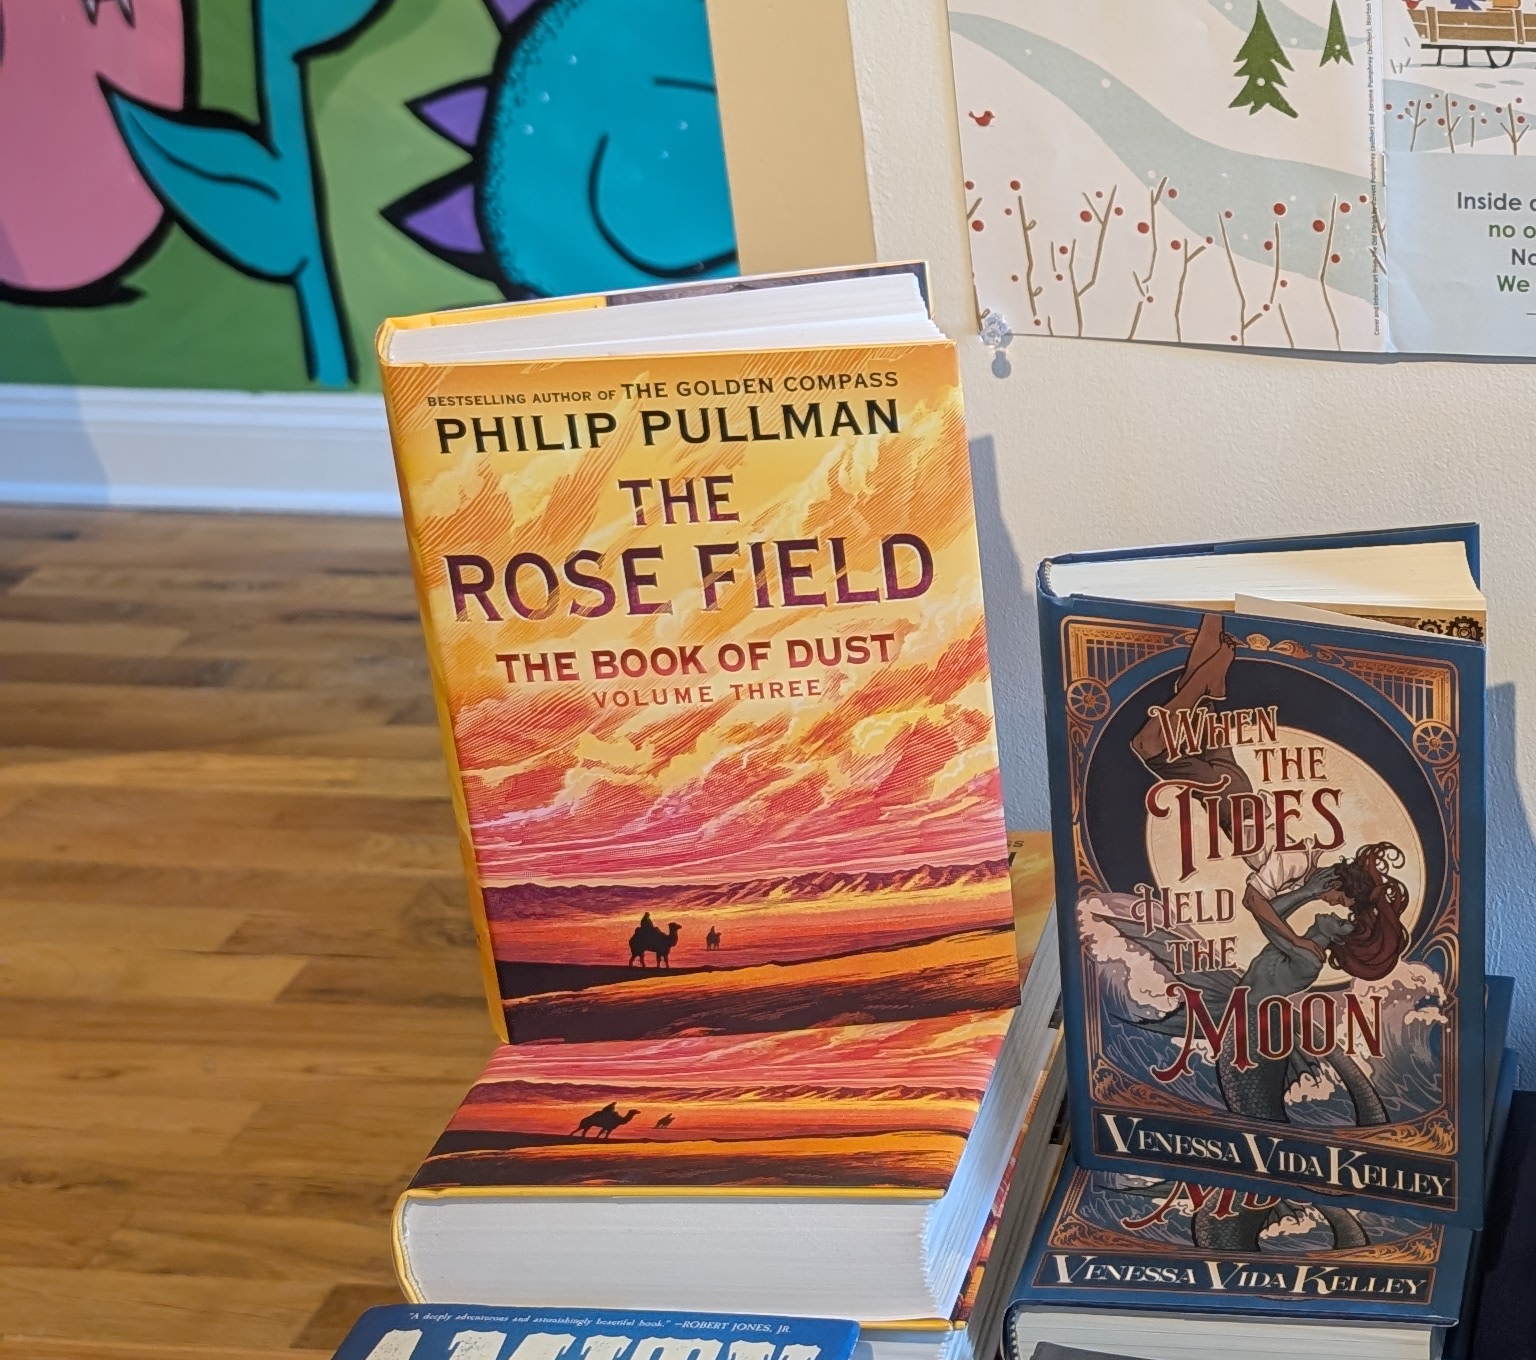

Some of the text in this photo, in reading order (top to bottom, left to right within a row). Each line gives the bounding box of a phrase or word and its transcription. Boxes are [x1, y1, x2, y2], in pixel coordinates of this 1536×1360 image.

[1457, 192, 1522, 212] Inside
[1489, 223, 1515, 238] no
[1497, 275, 1530, 292] We
[427, 371, 899, 406] BESTSELLING AUTHOR OF THE GOLDEN COMPASS
[435, 399, 900, 454] PHILIP PULLMAN
[617, 474, 740, 527] THE
[444, 533, 934, 623] ROSE FIELD
[495, 633, 895, 684] THE BOOK OF DUST
[592, 679, 823, 709] VOLUME THREE
[1148, 704, 1279, 764] WHEN
[1254, 746, 1328, 782] THE
[1146, 774, 1346, 881] TIDES
[1132, 884, 1235, 940] HELD
[1166, 937, 1238, 973] THE
[1151, 984, 1384, 1084] MOON
[1101, 1113, 1452, 1196] VENESSA VIDA KELLEY
